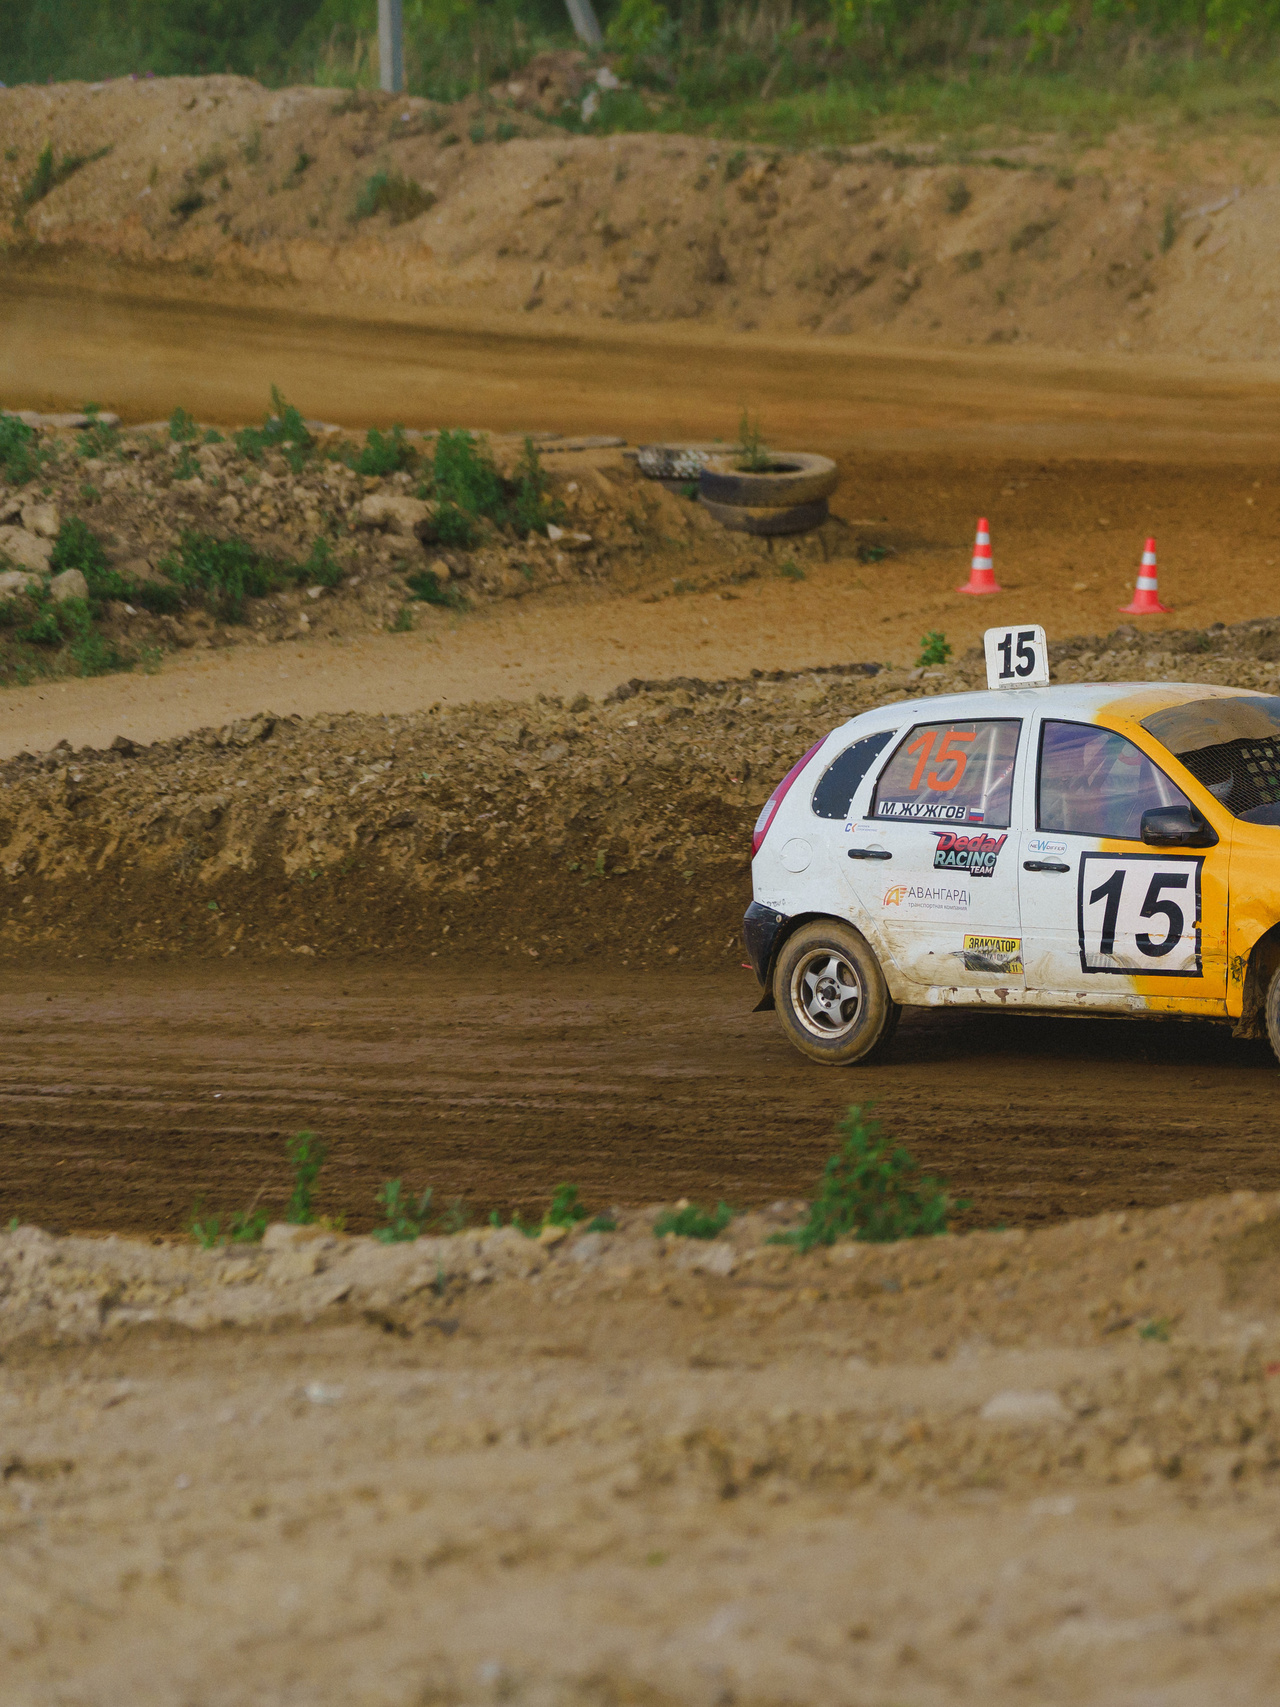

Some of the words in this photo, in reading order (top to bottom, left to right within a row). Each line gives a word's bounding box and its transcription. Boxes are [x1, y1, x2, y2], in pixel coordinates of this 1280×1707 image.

[998, 630, 1036, 679] 15
[907, 731, 977, 792] 15
[881, 802, 966, 819] М.ЖУЖГОВ
[930, 831, 1008, 855] Dedal
[934, 850, 997, 867] RACING
[970, 865, 994, 875] TEAM
[907, 886, 967, 905] АВАНГАРД
[1089, 870, 1190, 957] 15
